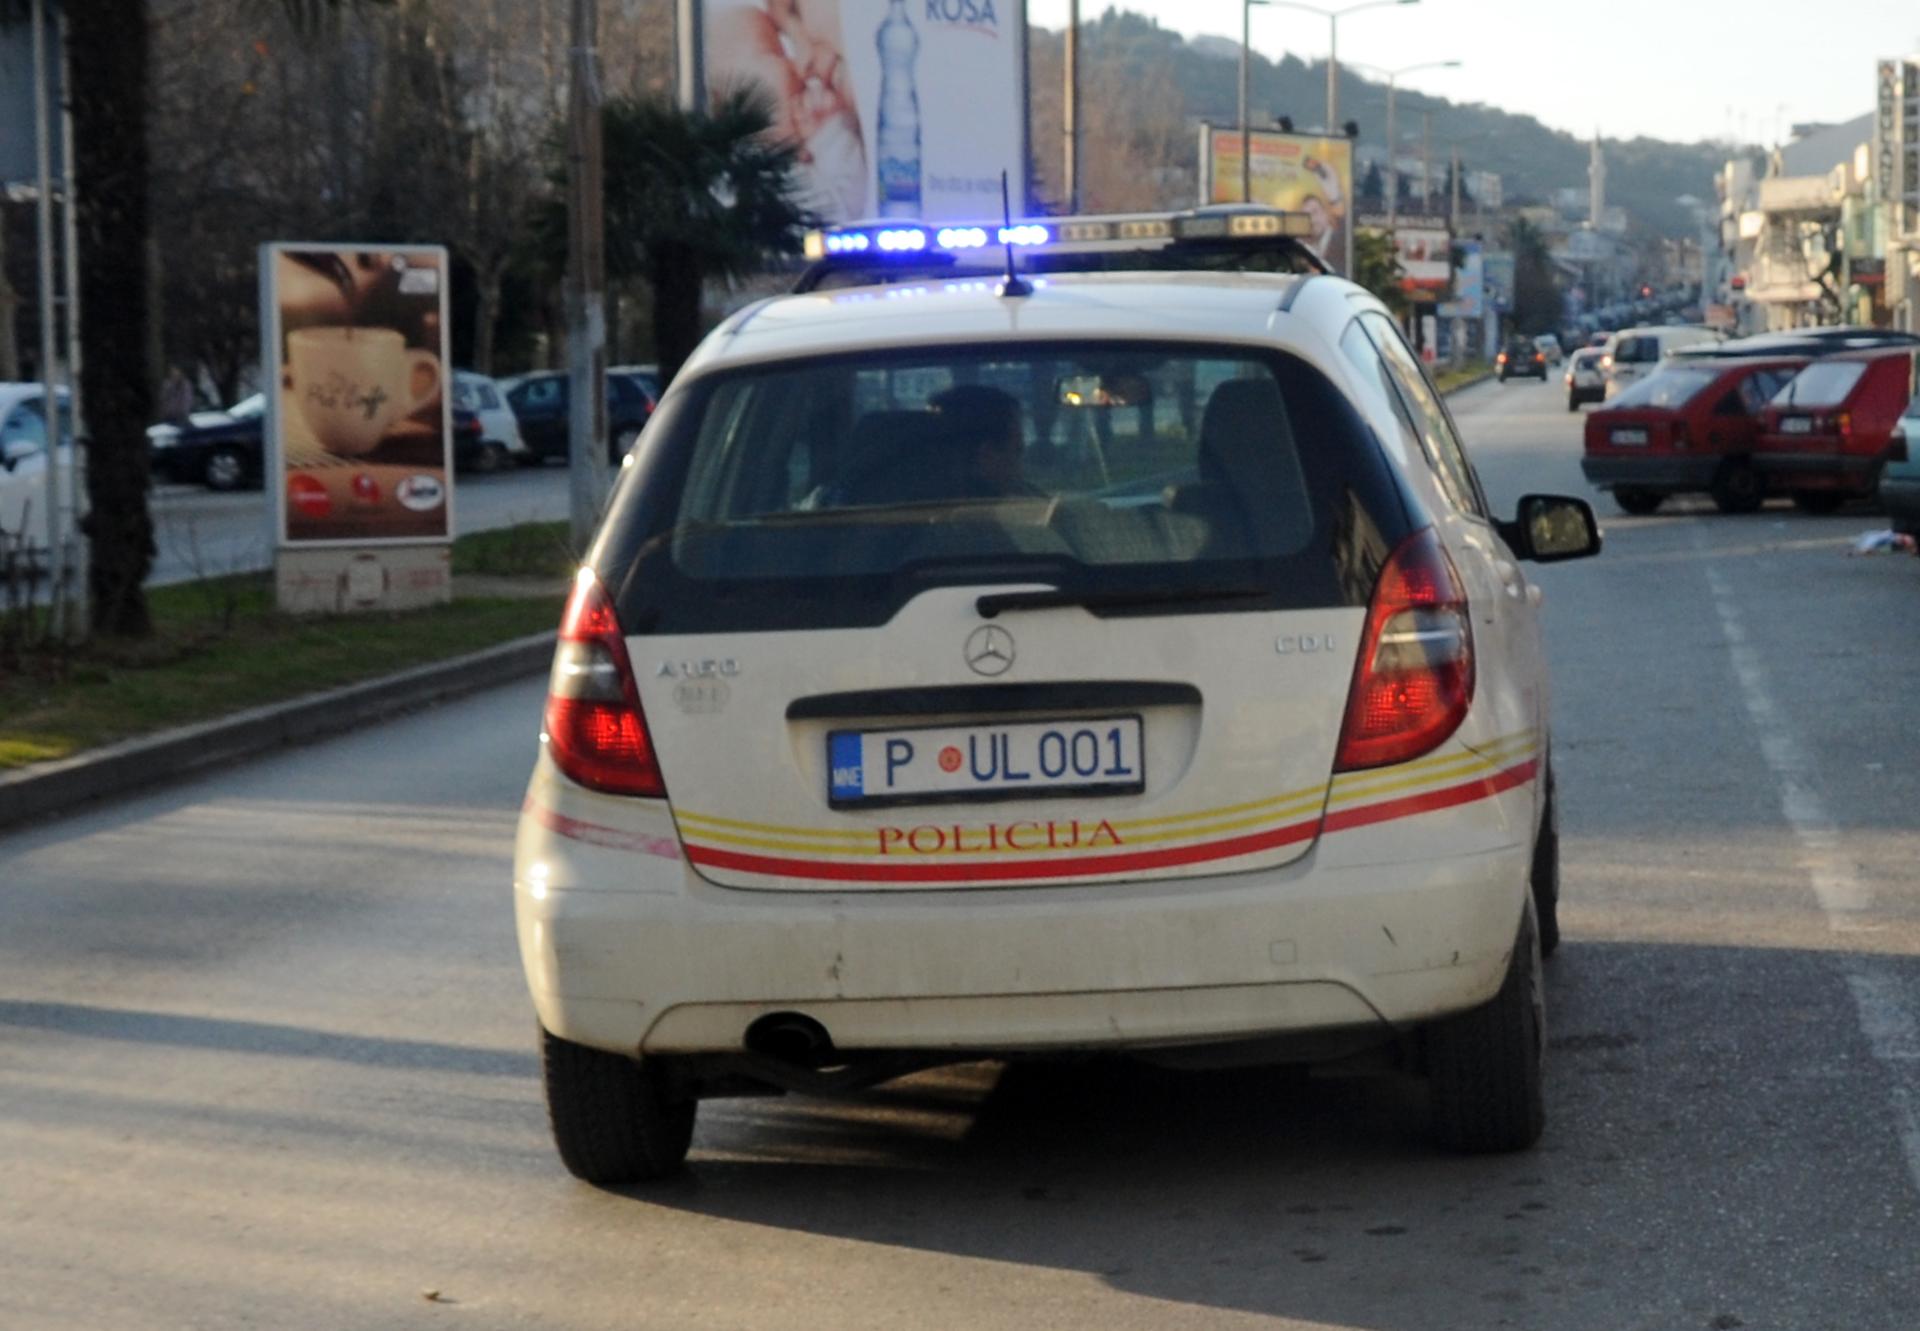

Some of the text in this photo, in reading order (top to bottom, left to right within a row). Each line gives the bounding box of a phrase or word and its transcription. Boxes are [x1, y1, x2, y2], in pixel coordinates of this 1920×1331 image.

[926, 0, 998, 24] ROSA
[1275, 634, 1336, 654] CDI
[886, 738, 914, 787] P
[877, 819, 1124, 855] POLICIJA
